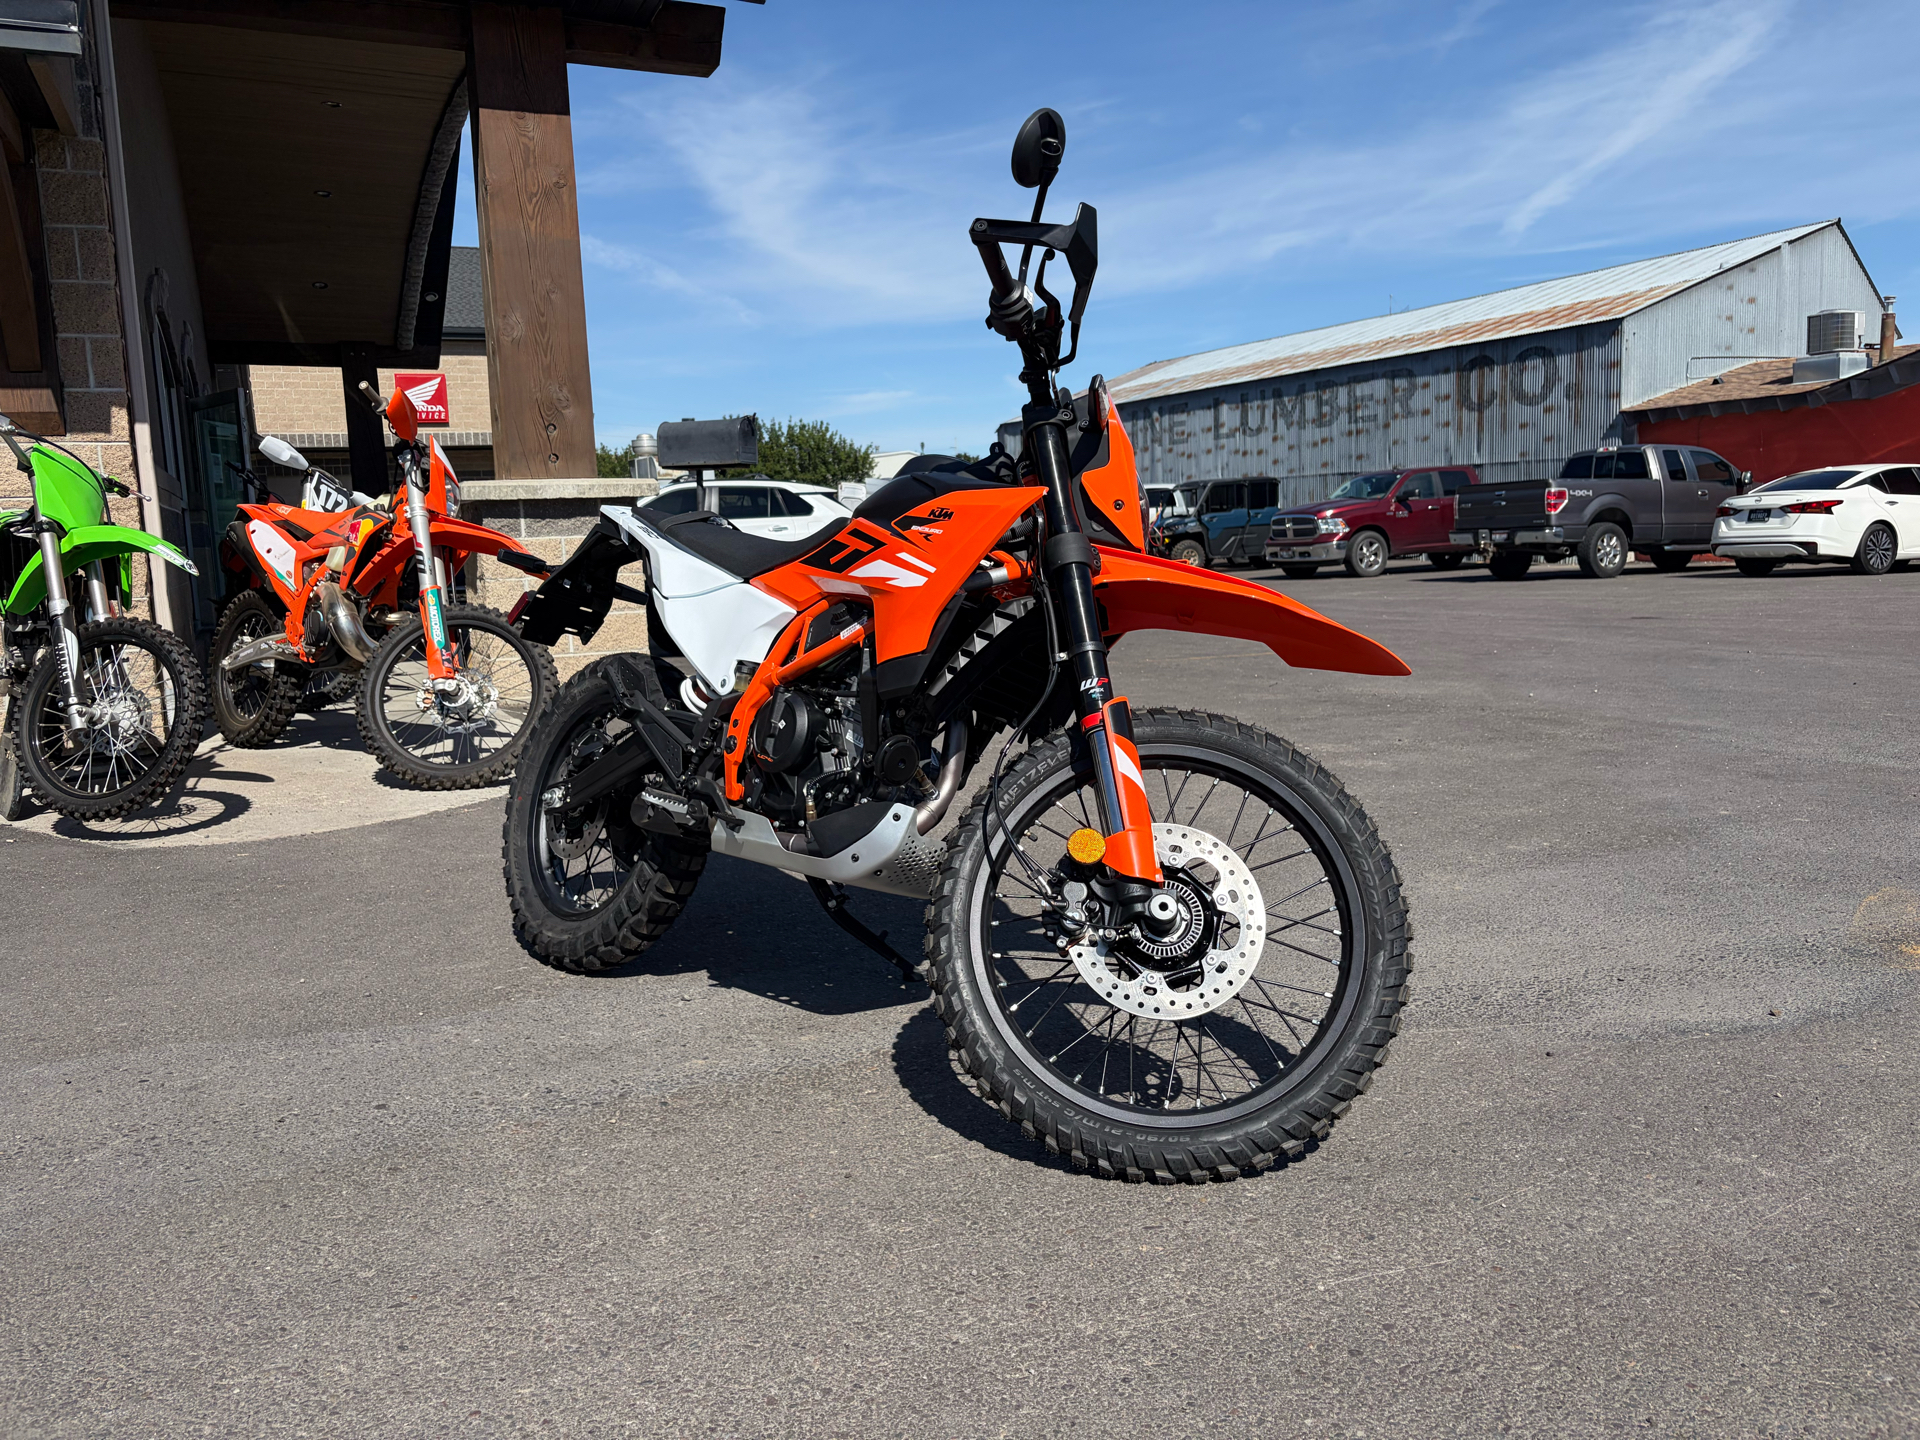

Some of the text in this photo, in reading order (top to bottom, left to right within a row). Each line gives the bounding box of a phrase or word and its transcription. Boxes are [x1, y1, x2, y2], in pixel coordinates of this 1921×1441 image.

[1213, 367, 1416, 441] LUMBER
[1460, 346, 1578, 413] CO.
[415, 404, 446, 412] NDA
[417, 412, 446, 420] VICE
[319, 483, 349, 513] 172
[927, 506, 955, 520] KTM
[911, 525, 943, 534] ENDURO
[428, 605, 443, 642] MOTOREX
